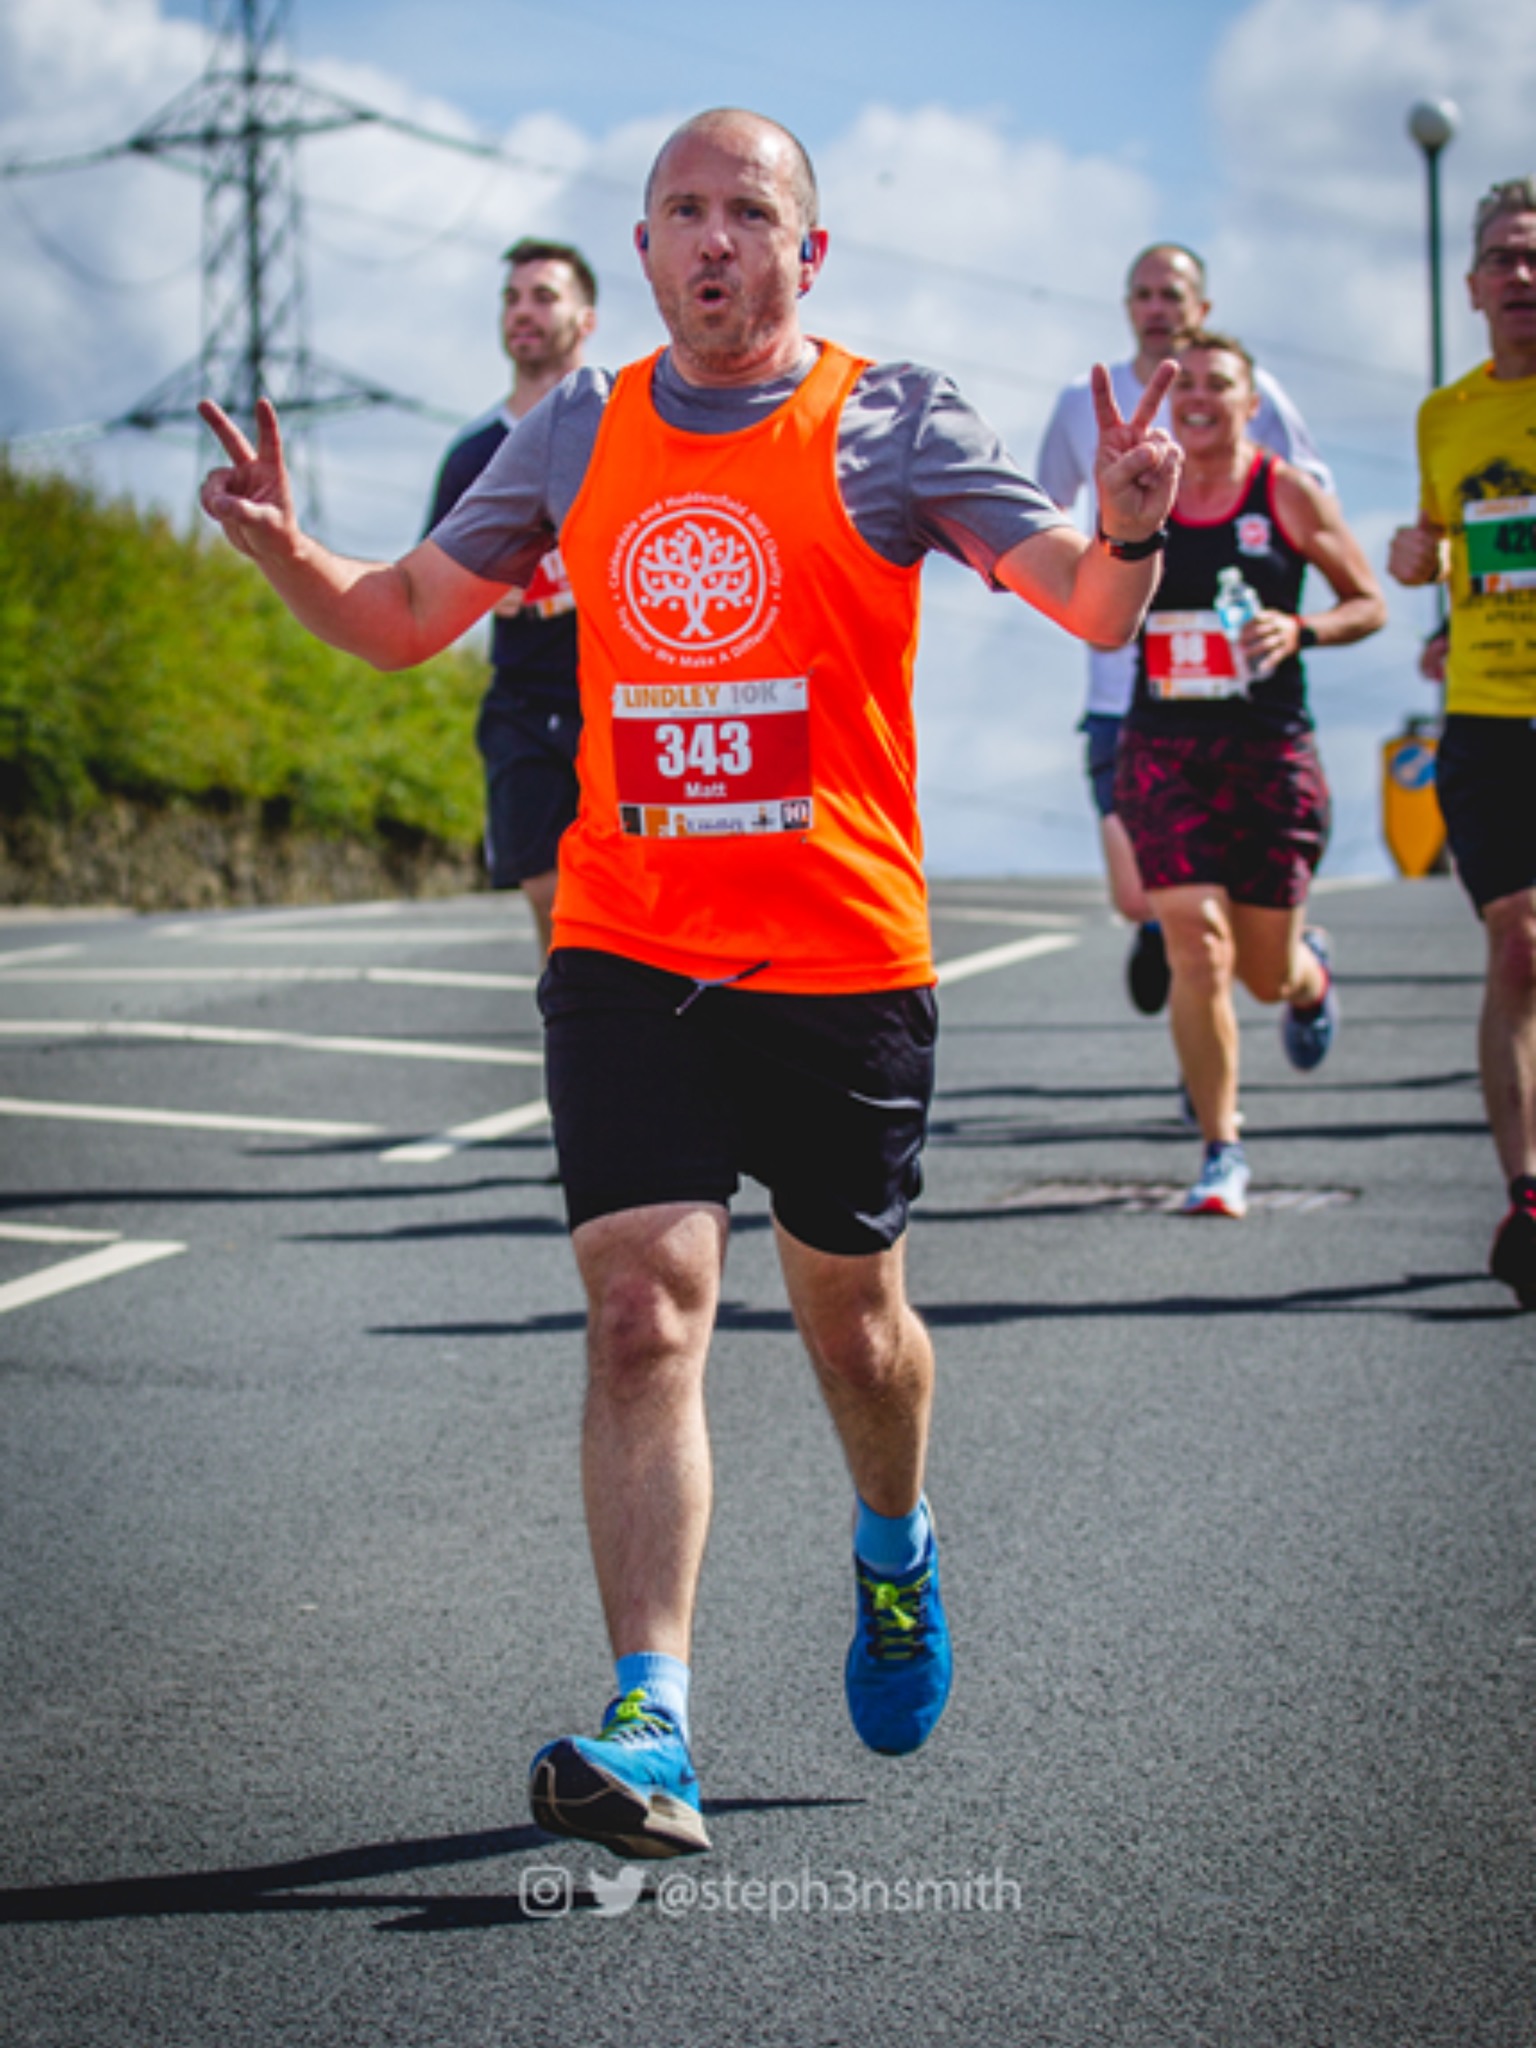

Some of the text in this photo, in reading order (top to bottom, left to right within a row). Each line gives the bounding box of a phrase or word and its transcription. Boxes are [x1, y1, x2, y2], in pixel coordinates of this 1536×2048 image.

[679, 655, 716, 667] Make
[622, 682, 778, 709] LINDLEY 10K
[655, 720, 753, 779] 343
[684, 782, 728, 799] Matt
